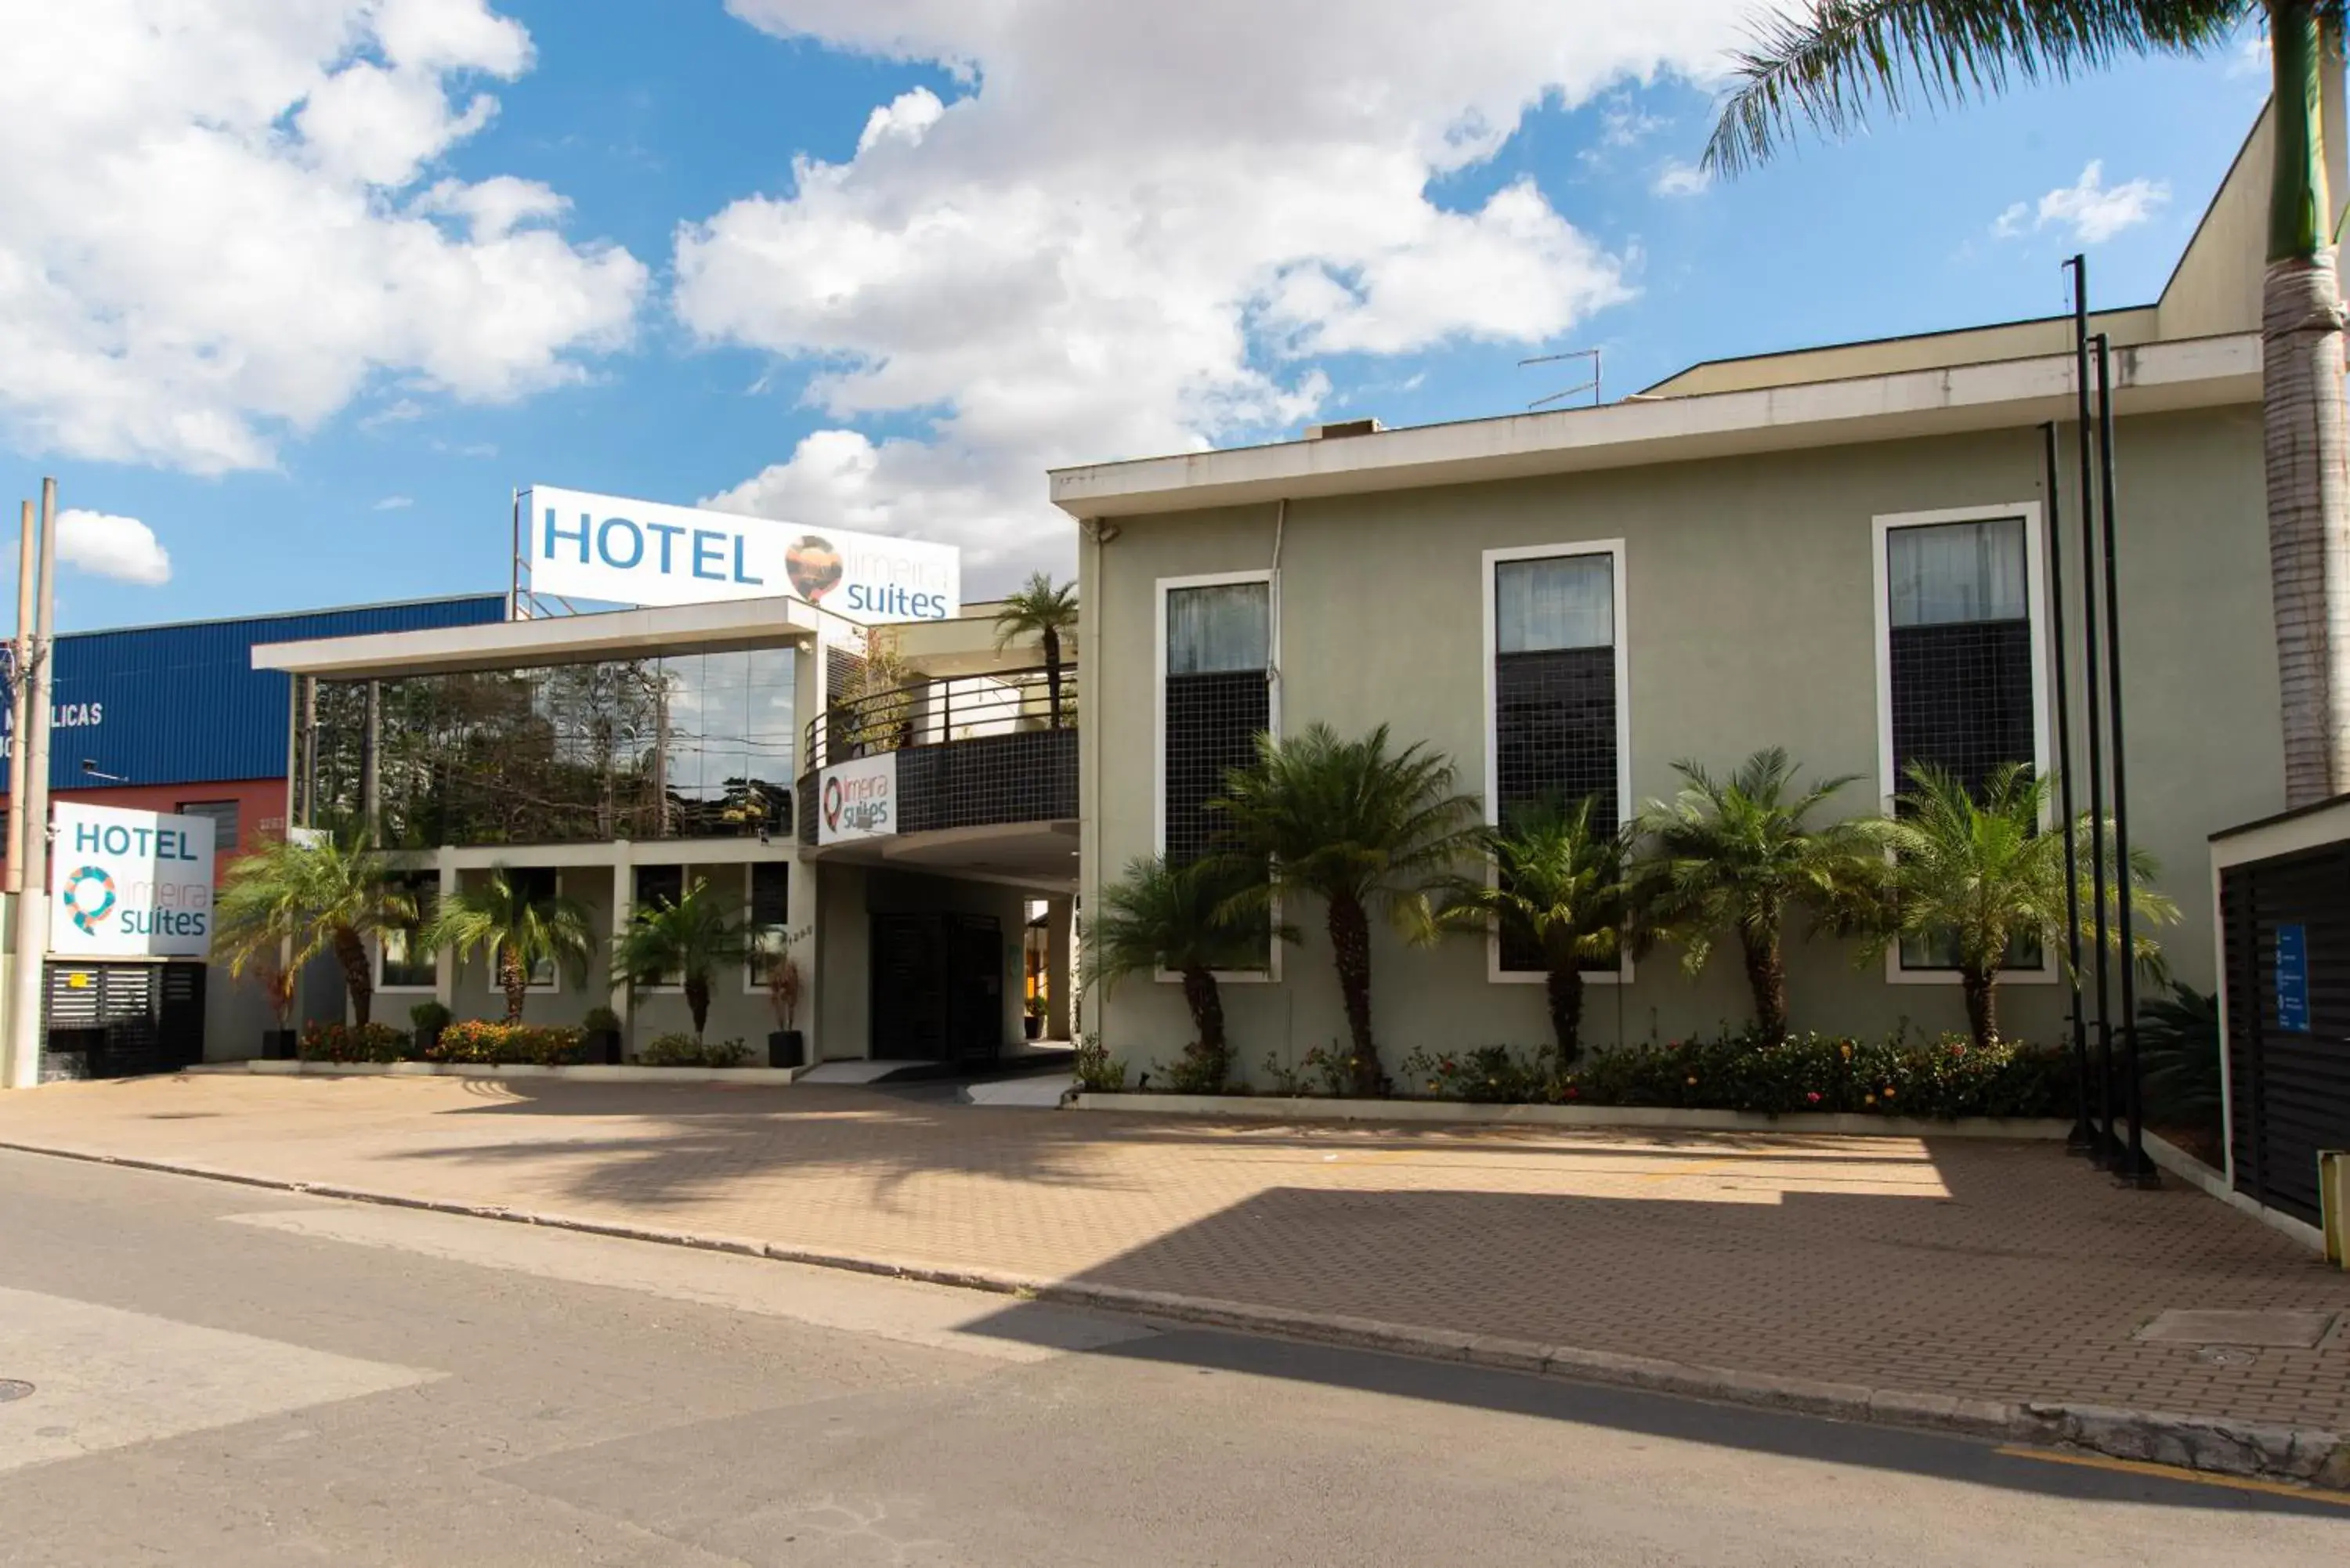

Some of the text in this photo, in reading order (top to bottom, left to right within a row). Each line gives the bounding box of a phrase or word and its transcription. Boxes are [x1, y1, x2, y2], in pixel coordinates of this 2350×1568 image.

[544, 508, 764, 586] HOTEL
[848, 582, 946, 619] suites
[844, 800, 888, 829] suites
[76, 822, 198, 861] HOTEL
[121, 906, 206, 936] suites
